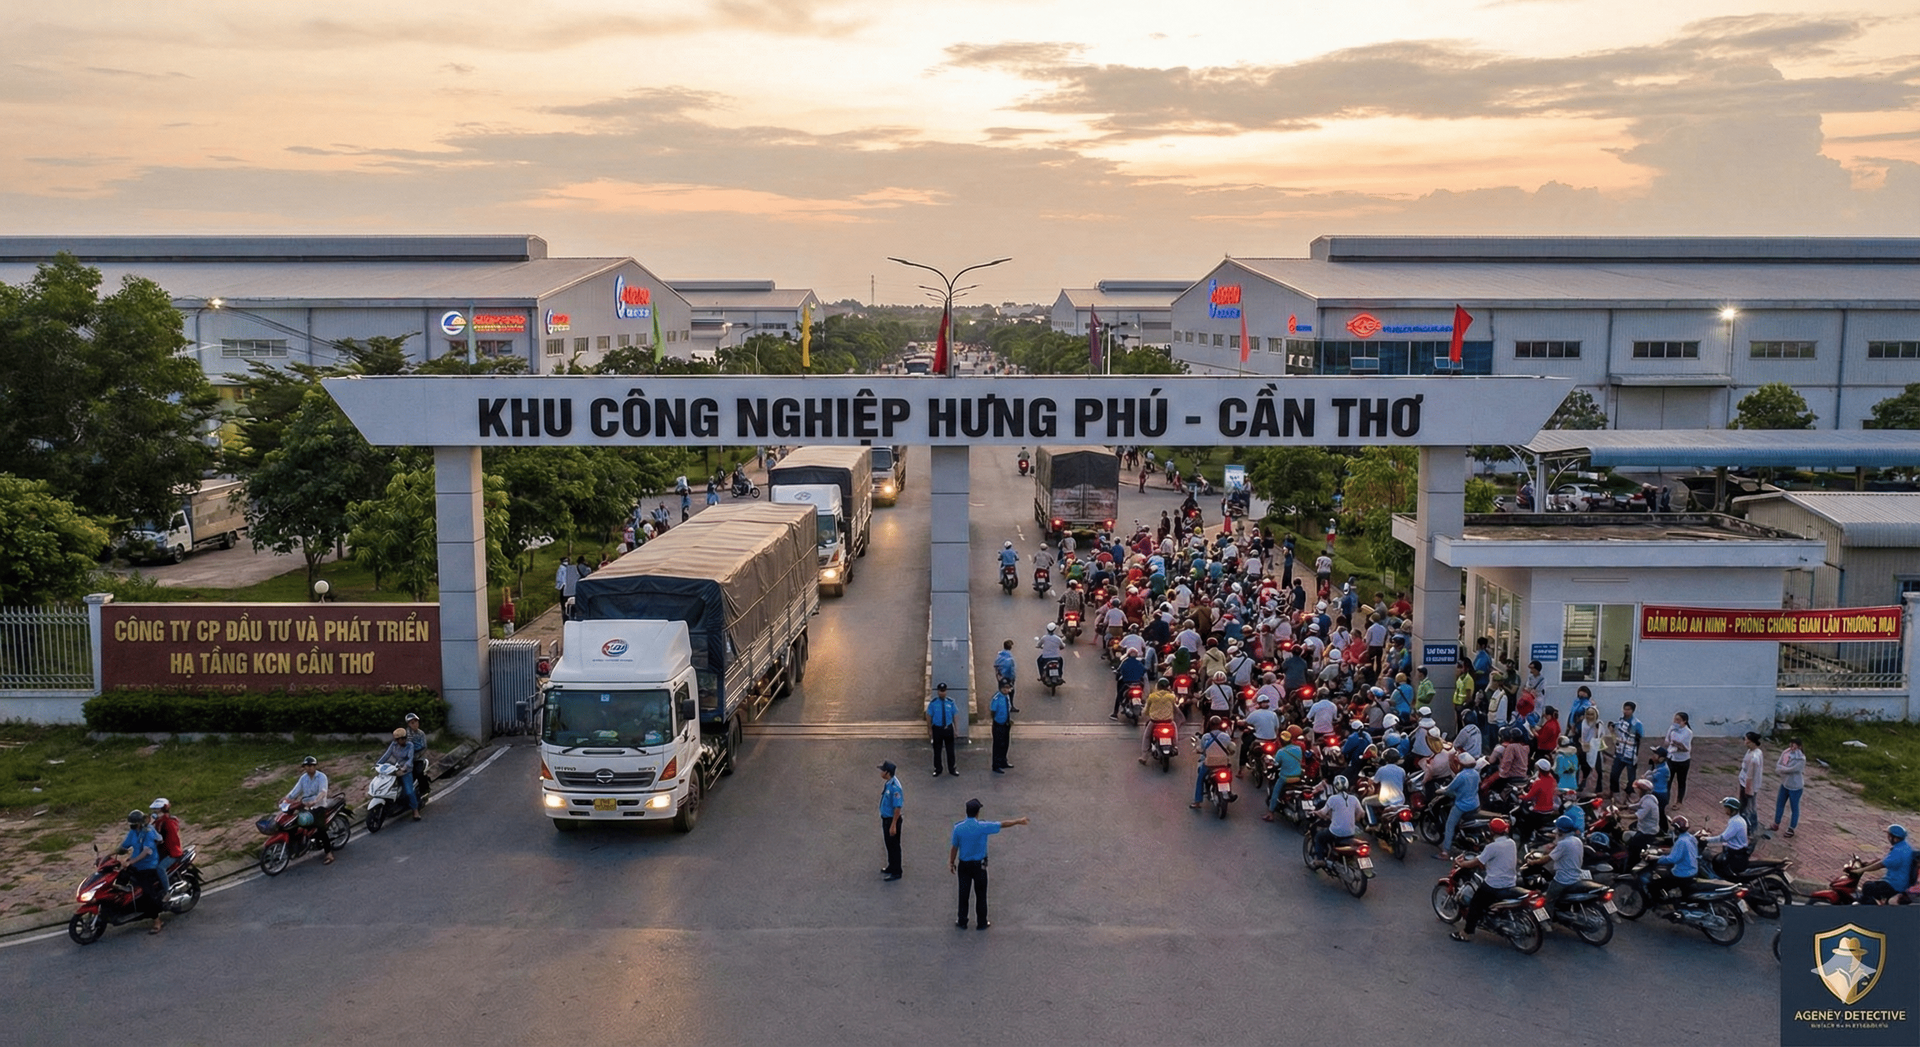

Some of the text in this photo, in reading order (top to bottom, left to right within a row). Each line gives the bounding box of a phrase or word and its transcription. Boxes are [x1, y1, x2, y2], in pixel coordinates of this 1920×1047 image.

[478, 383, 1424, 446] KHU CÔNG NGHIỆP HƯNG PHÚ - CẦN THƠ
[114, 611, 429, 642] CÔNG TY CP ĐẦU TƯ VÀ PHÁT TRIỂN
[1690, 617, 1703, 633] AN
[1704, 617, 1727, 633] NINH
[1735, 613, 1765, 633] PHÒNG
[1798, 617, 1820, 633] GIAN
[170, 645, 375, 679] HẠ TẦNG KCN CẦN THƠ
